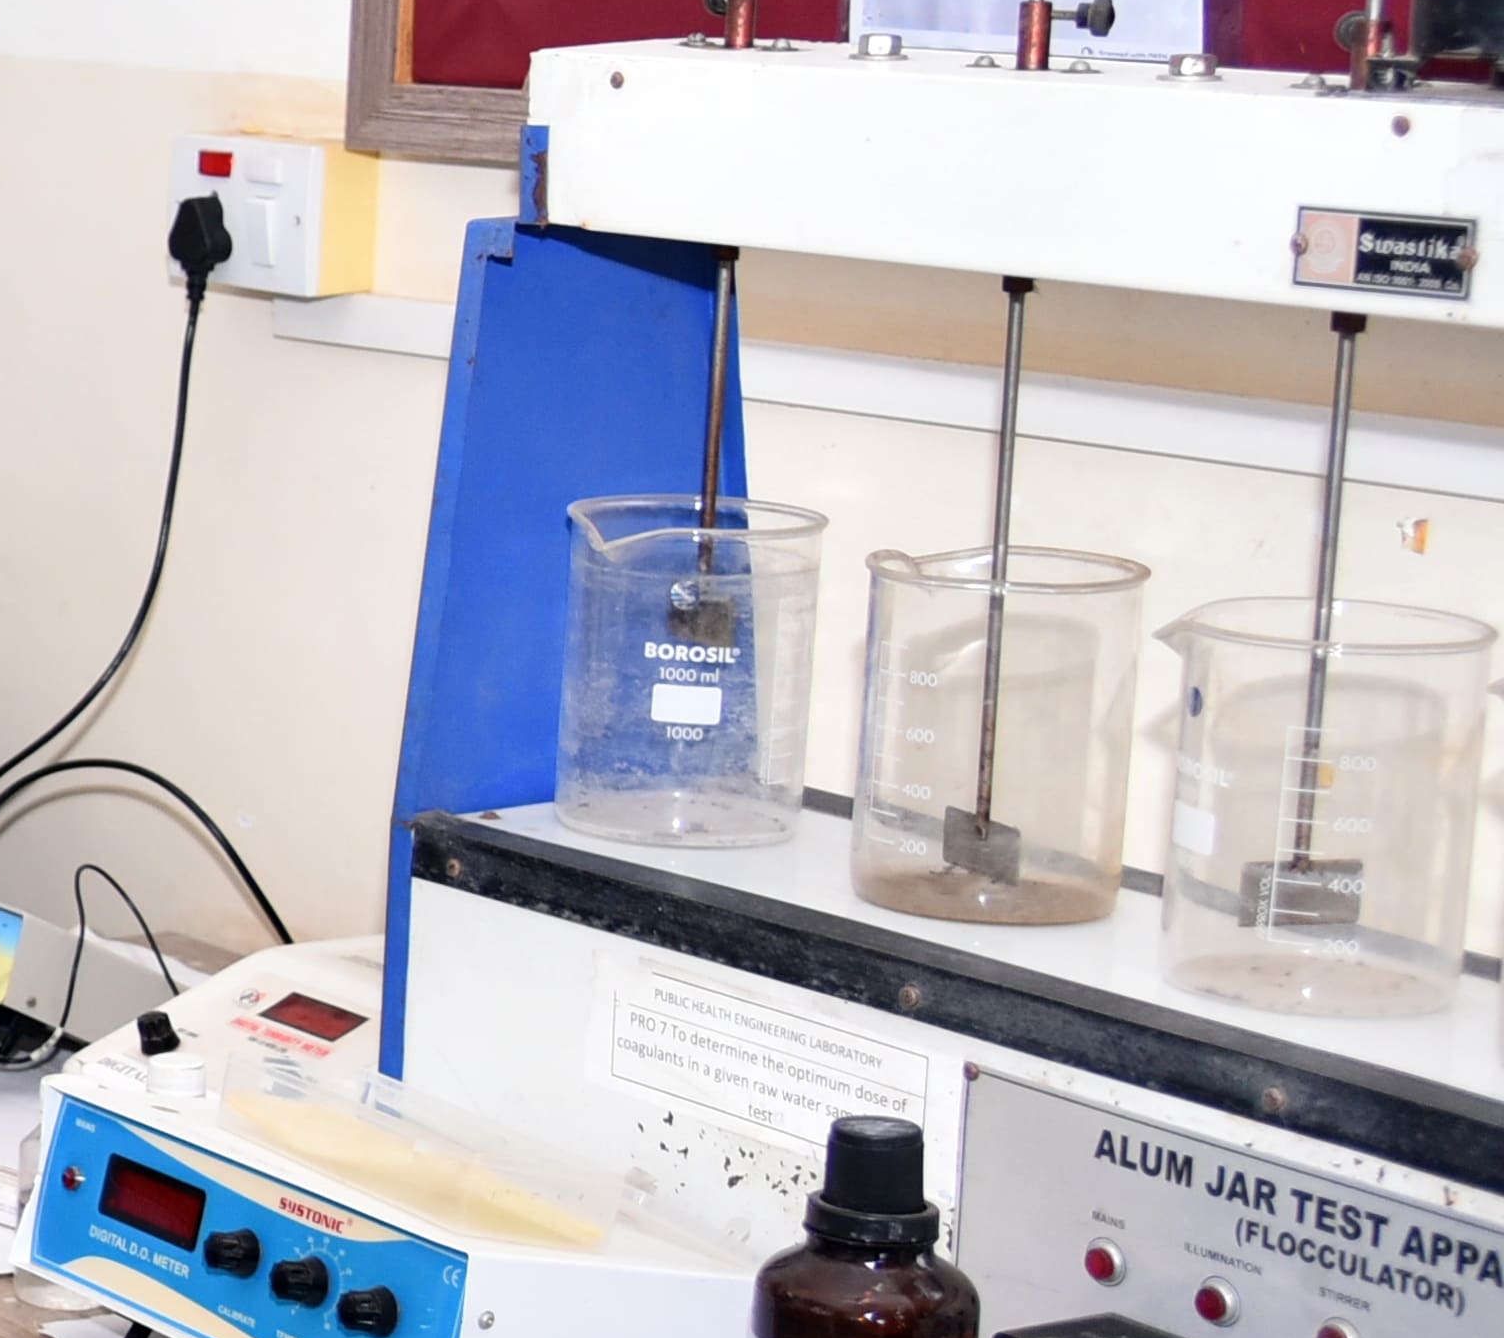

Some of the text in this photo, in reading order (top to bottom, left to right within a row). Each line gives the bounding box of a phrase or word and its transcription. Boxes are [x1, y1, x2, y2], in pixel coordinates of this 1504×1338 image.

[644, 642, 735, 664] BOROSIL
[659, 666, 720, 683] 1000 ml
[910, 670, 938, 687] 800
[666, 726, 703, 741] 1000
[906, 727, 935, 744] 600
[902, 782, 931, 799] 400
[898, 838, 927, 855] 200
[1327, 878, 1366, 894] 400
[654, 988, 883, 1069] PUBLIC HEALTH ENGINEERING LABORATORY
[630, 1011, 908, 1114] PRO 7 To determine the optimum dose of
[616, 1036, 685, 1068] coagulants
[687, 1055, 700, 1072] in
[703, 1063, 711, 1077] a
[713, 1068, 749, 1089] given
[752, 1080, 778, 1098] raw
[781, 1089, 822, 1112] water
[748, 1103, 773, 1124] test
[1094, 1129, 1194, 1188] ALUM
[1205, 1166, 1277, 1216] JAR
[1290, 1188, 1390, 1248] TEST
[278, 1196, 344, 1234] SYSTONIC
[1091, 1210, 1126, 1231] MAINS
[89, 1224, 190, 1279] DIGITAL D.O. METER
[1184, 1242, 1262, 1276] ILLUMINATION
[1235, 1218, 1466, 1317] (FLOCCULATOR)
[1319, 1286, 1371, 1312] STIRRER
